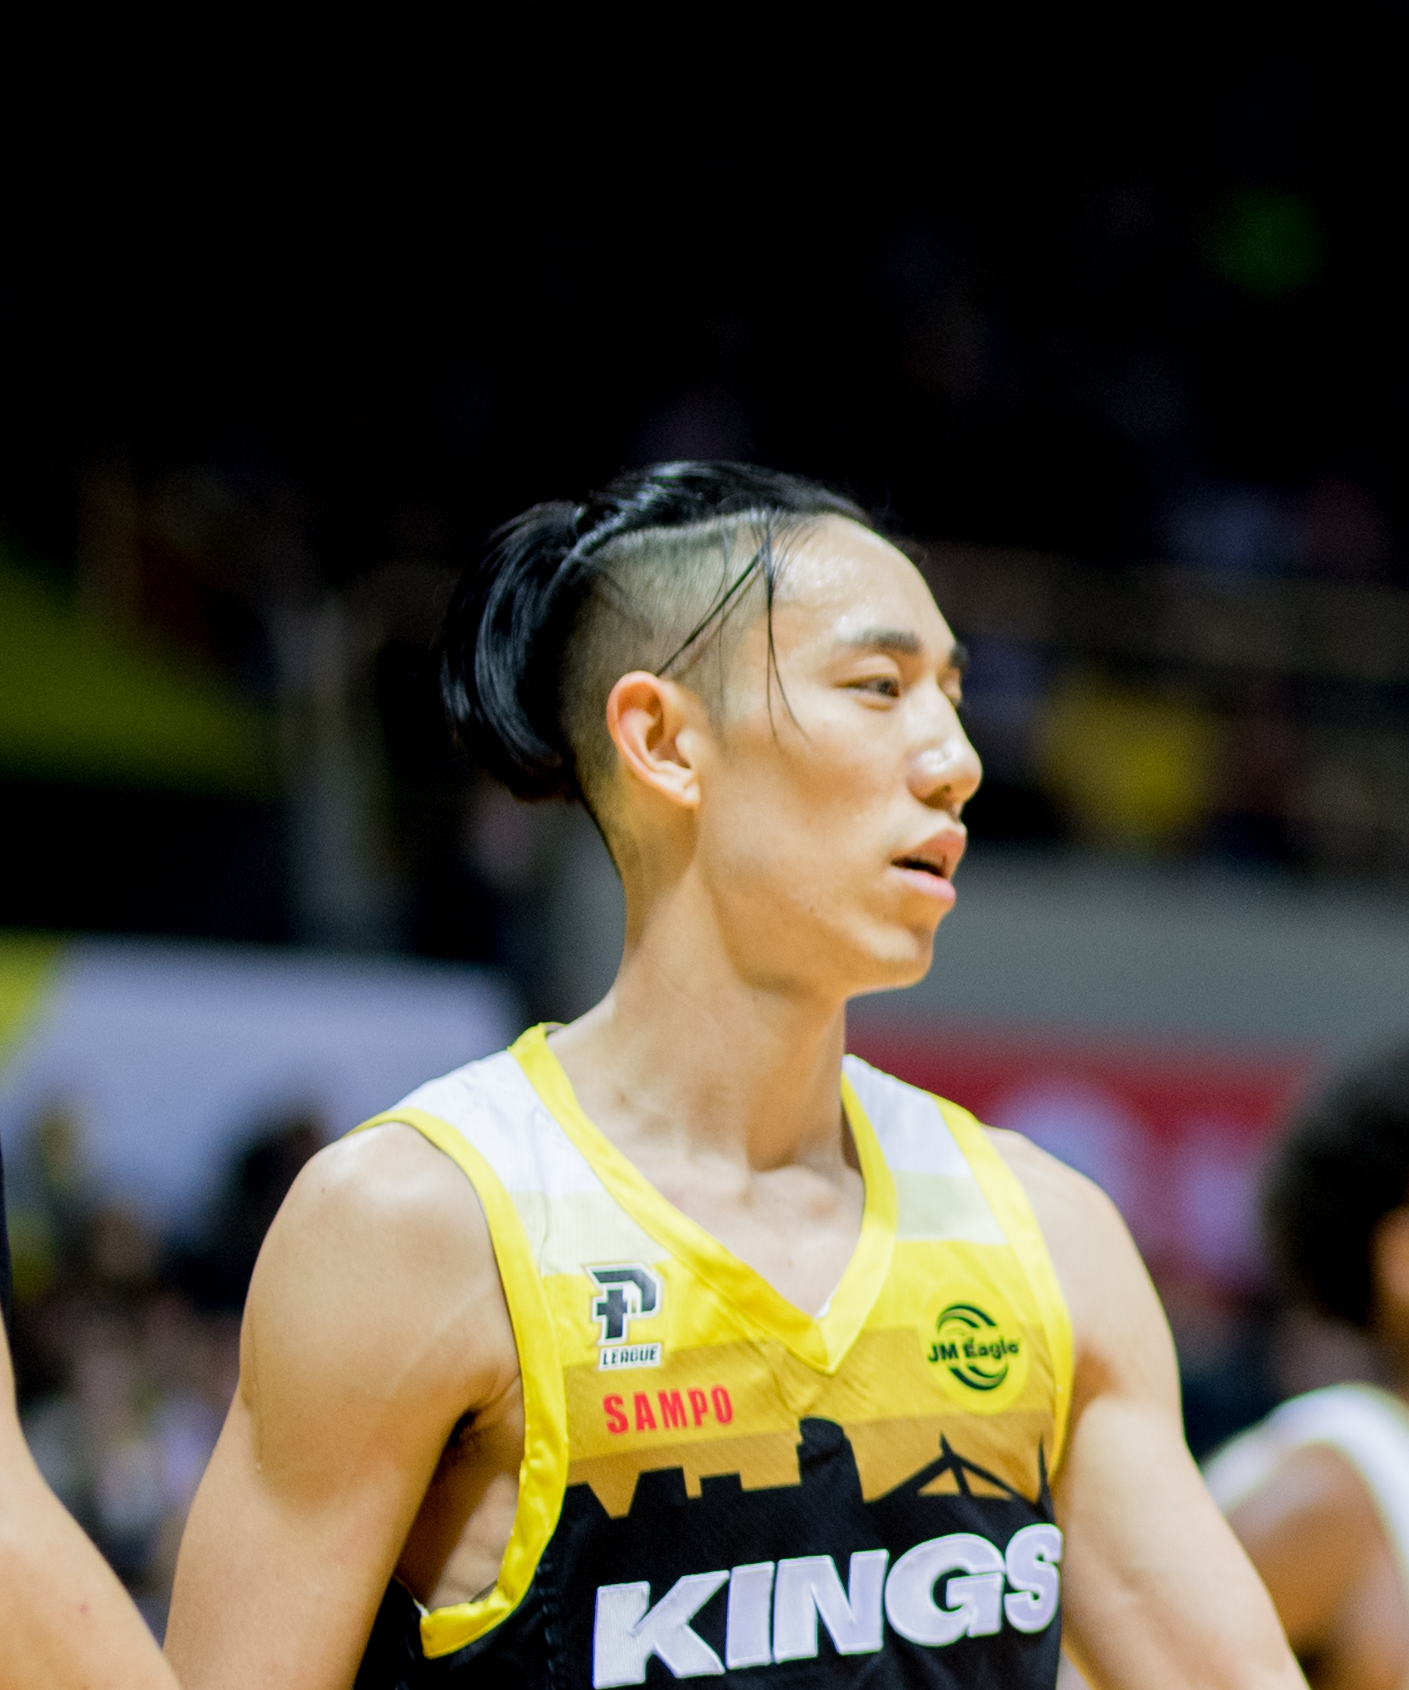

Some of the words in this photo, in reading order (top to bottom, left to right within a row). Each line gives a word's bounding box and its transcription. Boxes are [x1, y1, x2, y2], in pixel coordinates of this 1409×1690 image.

[602, 1346, 658, 1367] LEAGUE
[928, 1342, 959, 1362] JM
[963, 1336, 1019, 1360] Eagle
[602, 1384, 734, 1437] SAMPO
[593, 1523, 1064, 1690] KINGS
